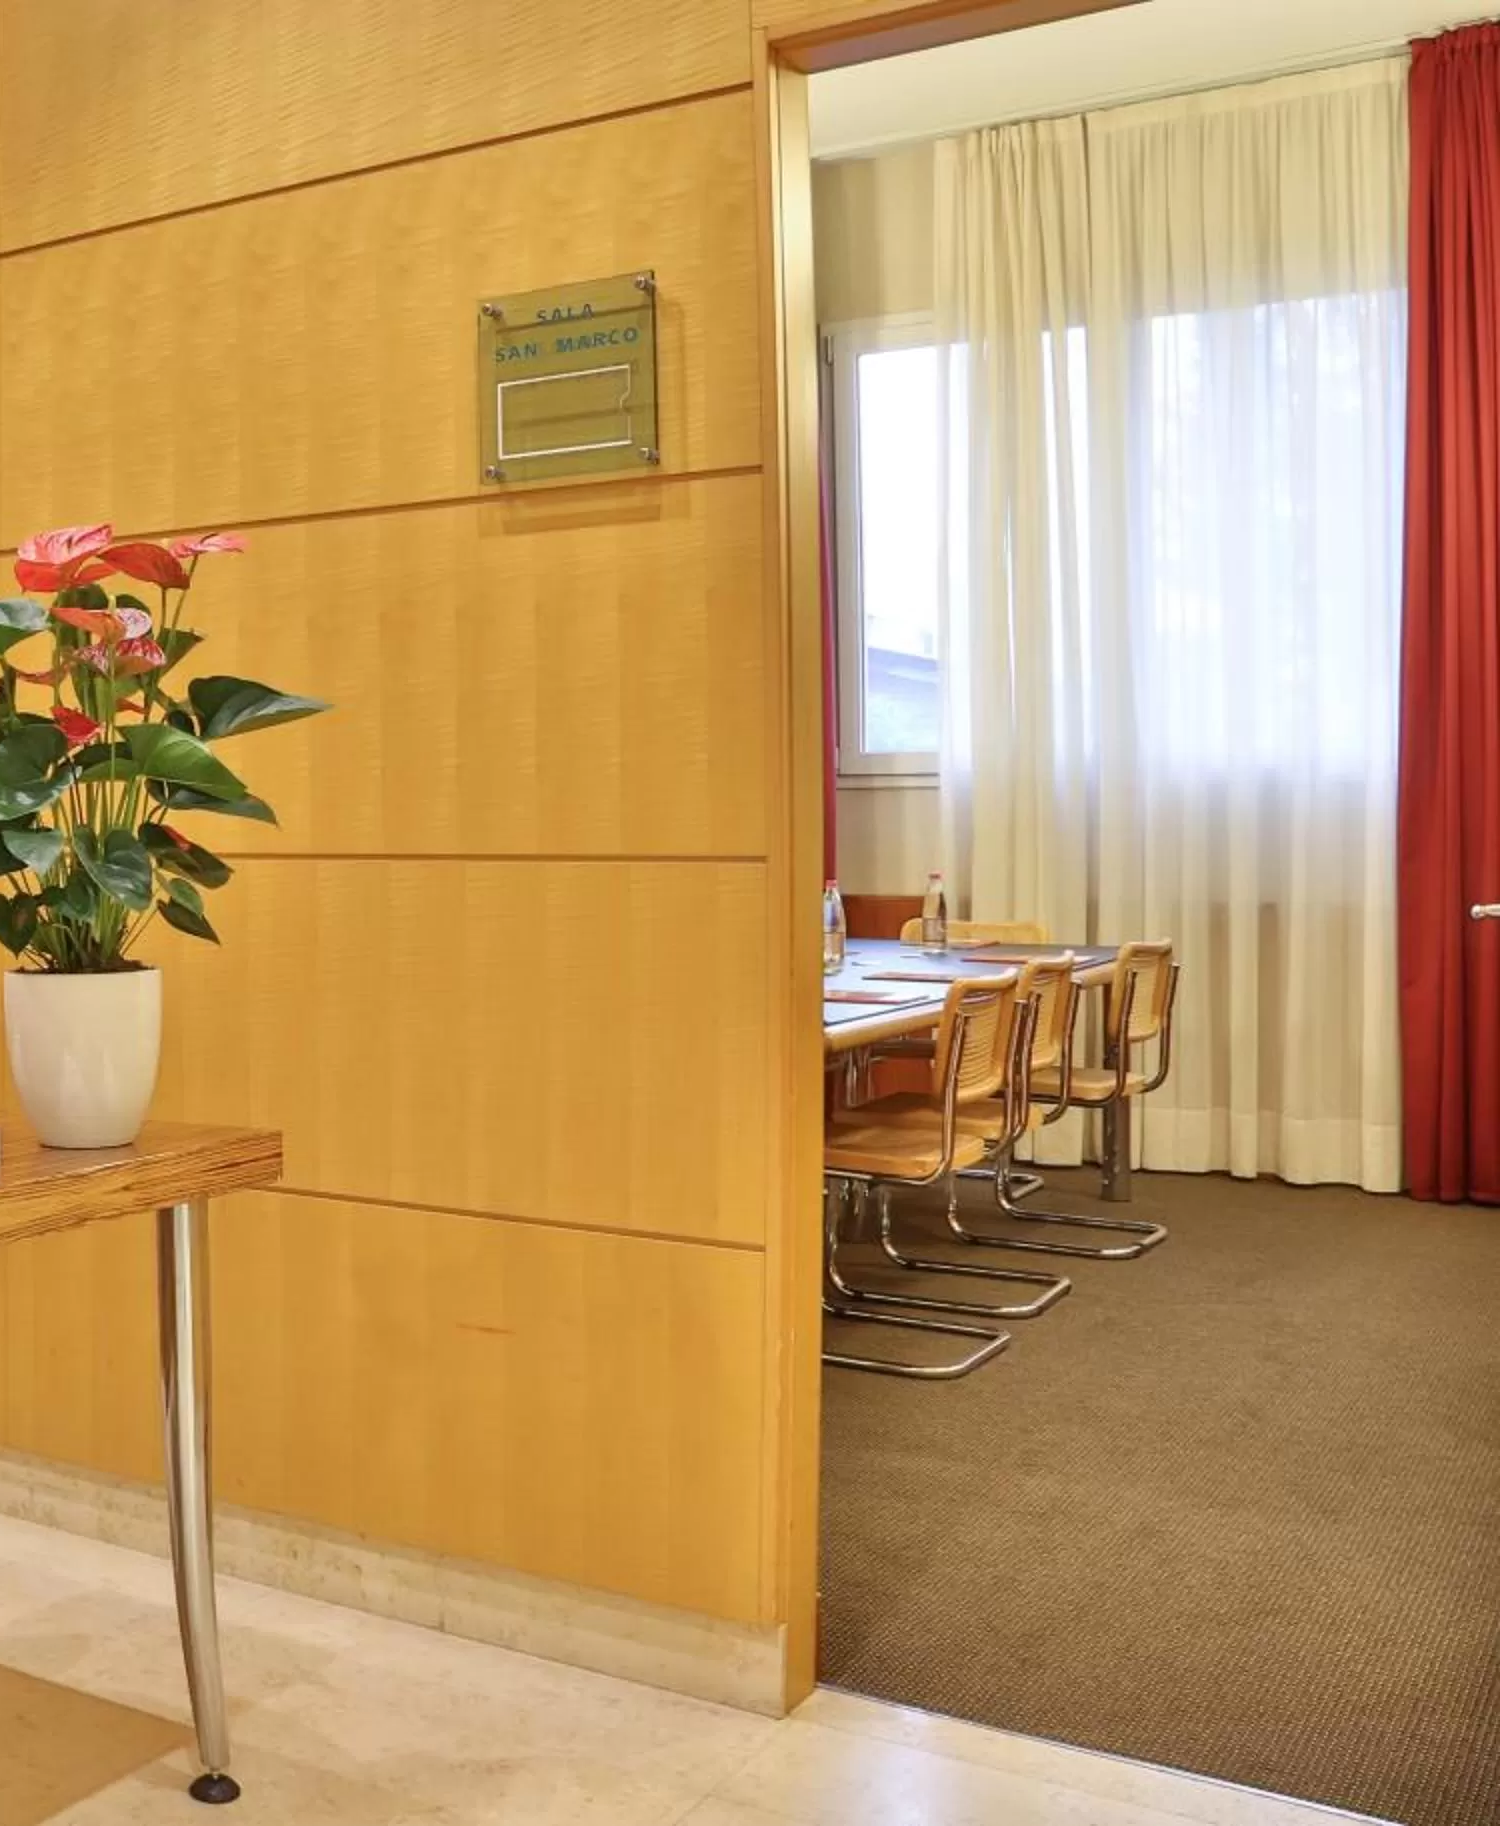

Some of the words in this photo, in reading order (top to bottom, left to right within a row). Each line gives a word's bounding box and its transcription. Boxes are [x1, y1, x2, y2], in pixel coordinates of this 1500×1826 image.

[537, 303, 595, 324] SALA
[495, 342, 538, 364] SAN
[555, 326, 639, 353] MARCO
